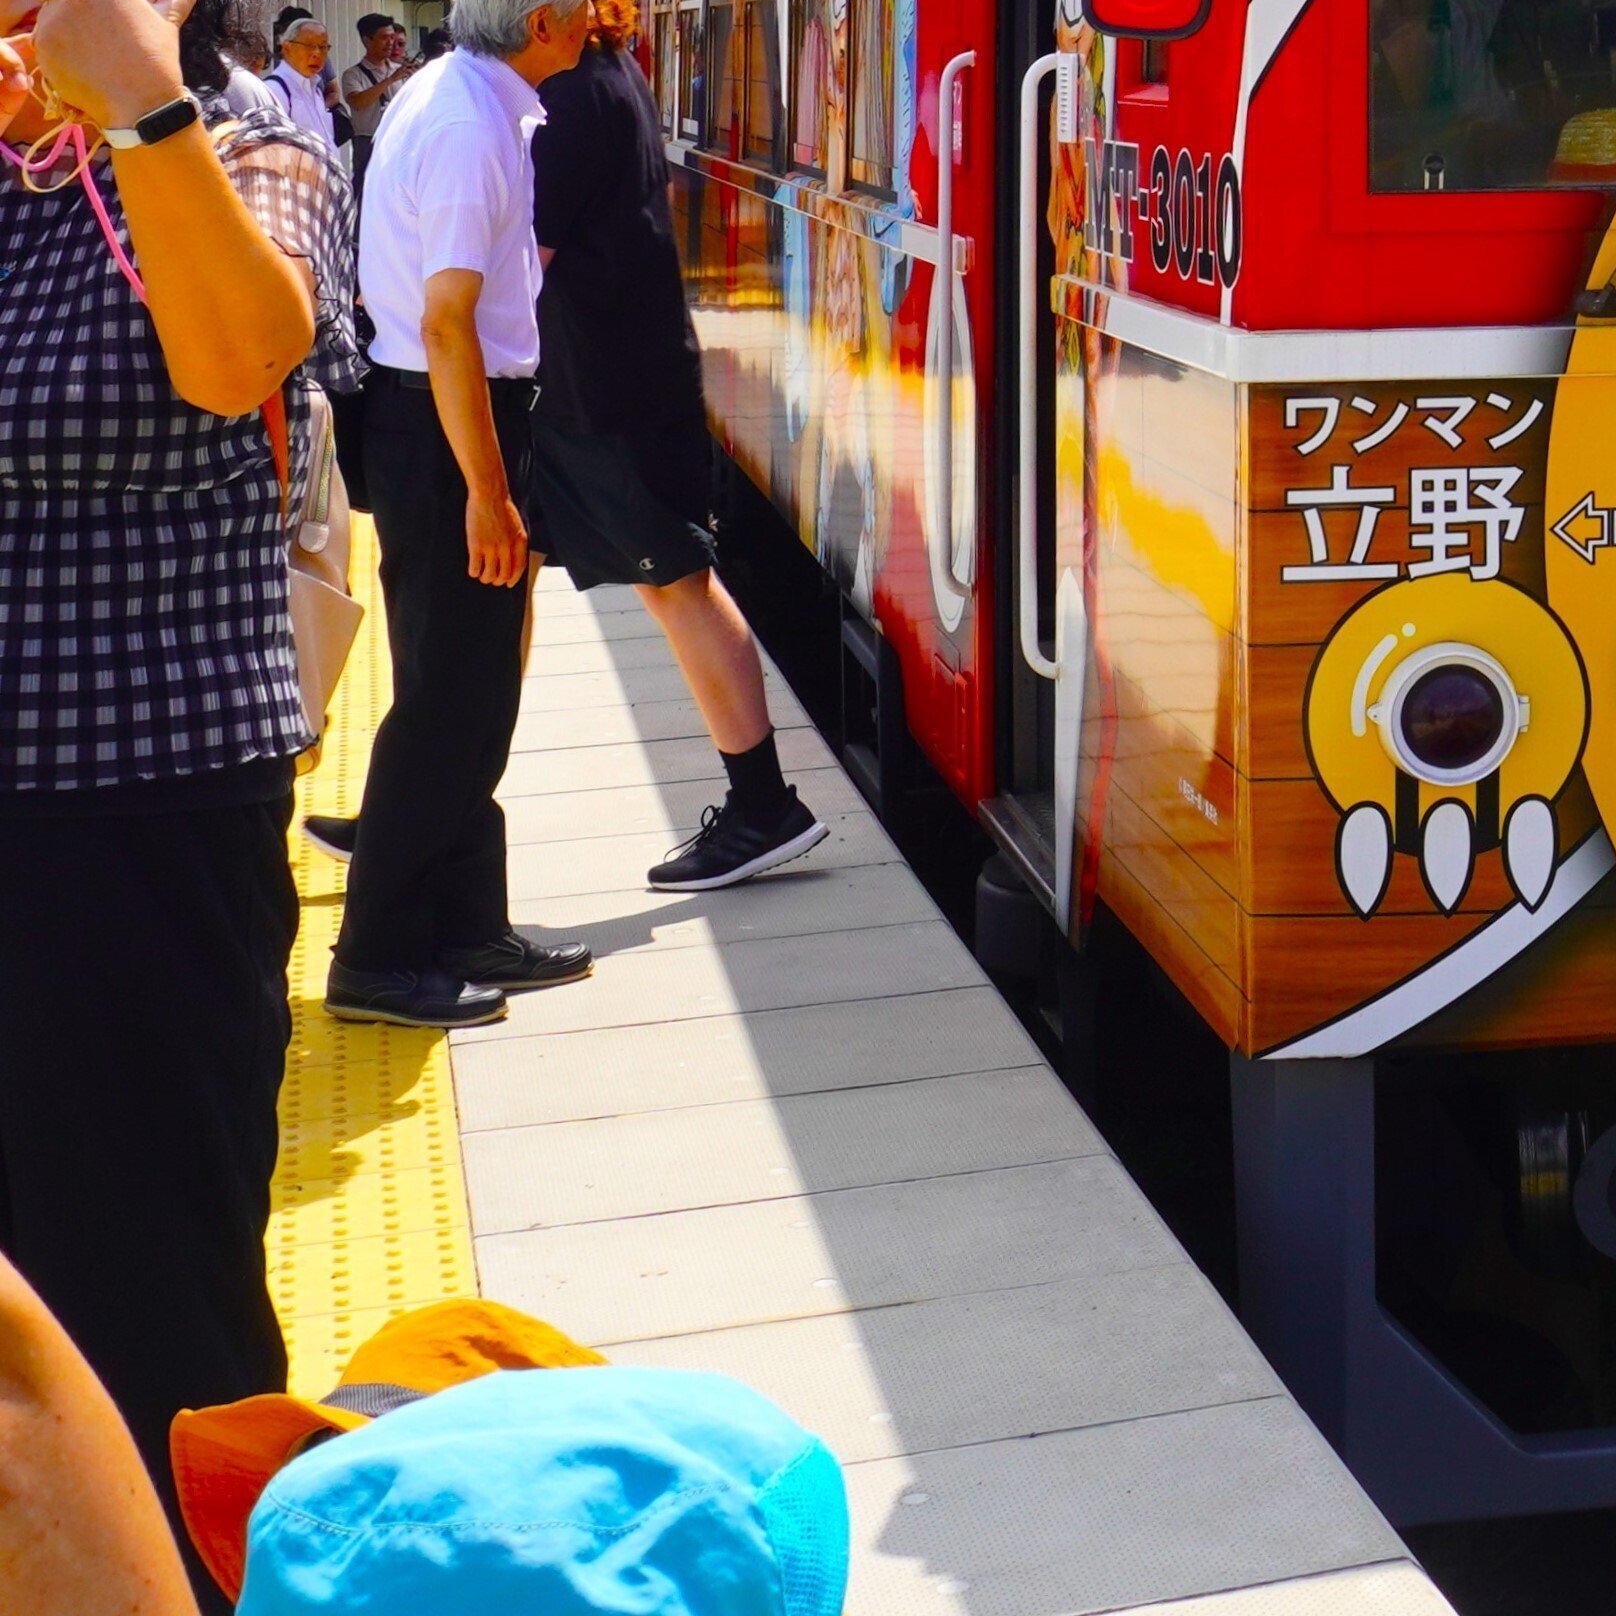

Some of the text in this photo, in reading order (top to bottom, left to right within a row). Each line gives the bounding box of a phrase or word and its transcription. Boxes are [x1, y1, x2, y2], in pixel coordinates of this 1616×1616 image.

[1084, 136, 1243, 289] MT-3010
[1283, 392, 1545, 456] ワンマン
[1280, 465, 1525, 583] 立野
